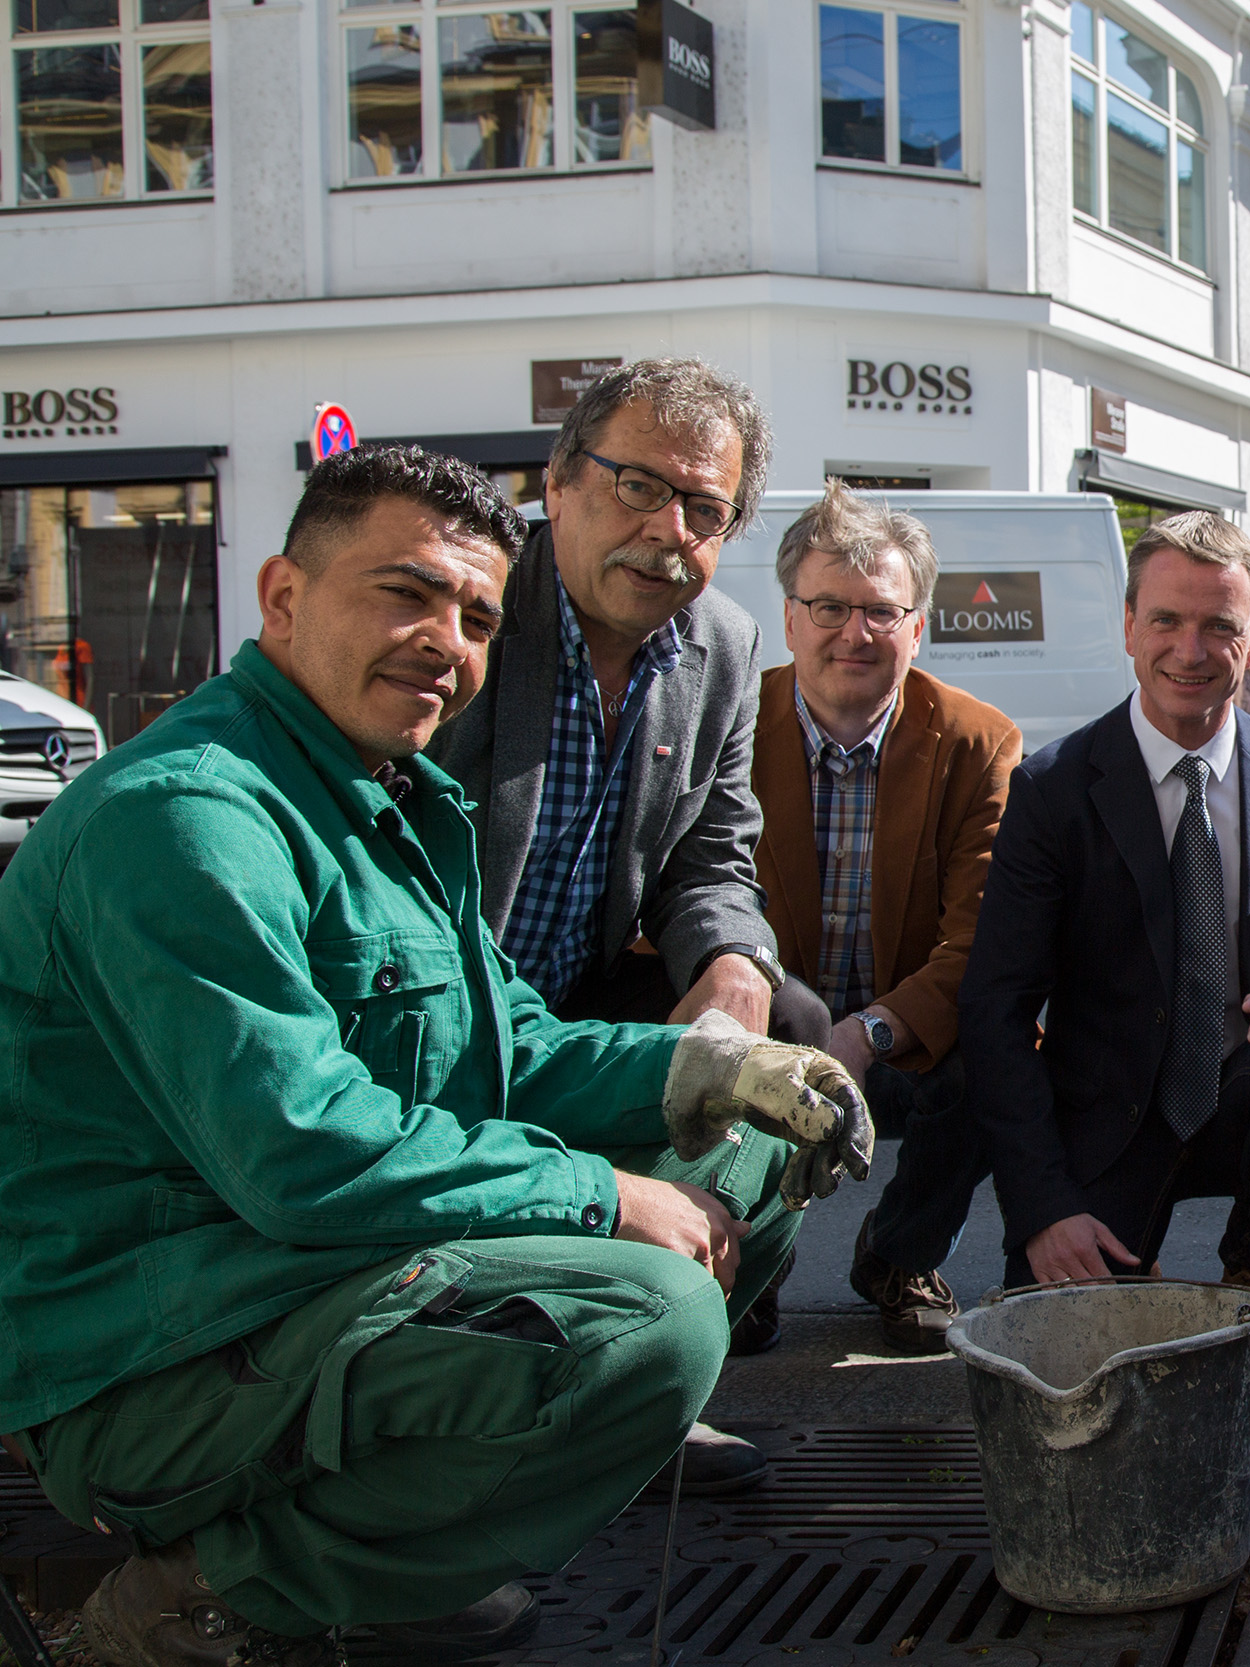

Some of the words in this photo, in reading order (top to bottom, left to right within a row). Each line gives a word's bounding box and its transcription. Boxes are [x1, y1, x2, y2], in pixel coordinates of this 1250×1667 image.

[668, 36, 711, 81] BOSS
[847, 359, 973, 402] BOSS
[3, 387, 119, 426] BOSS
[938, 608, 1034, 632] LOOMIS
[929, 650, 975, 661] Managing
[977, 648, 1000, 659] cash
[1003, 648, 1011, 657] in
